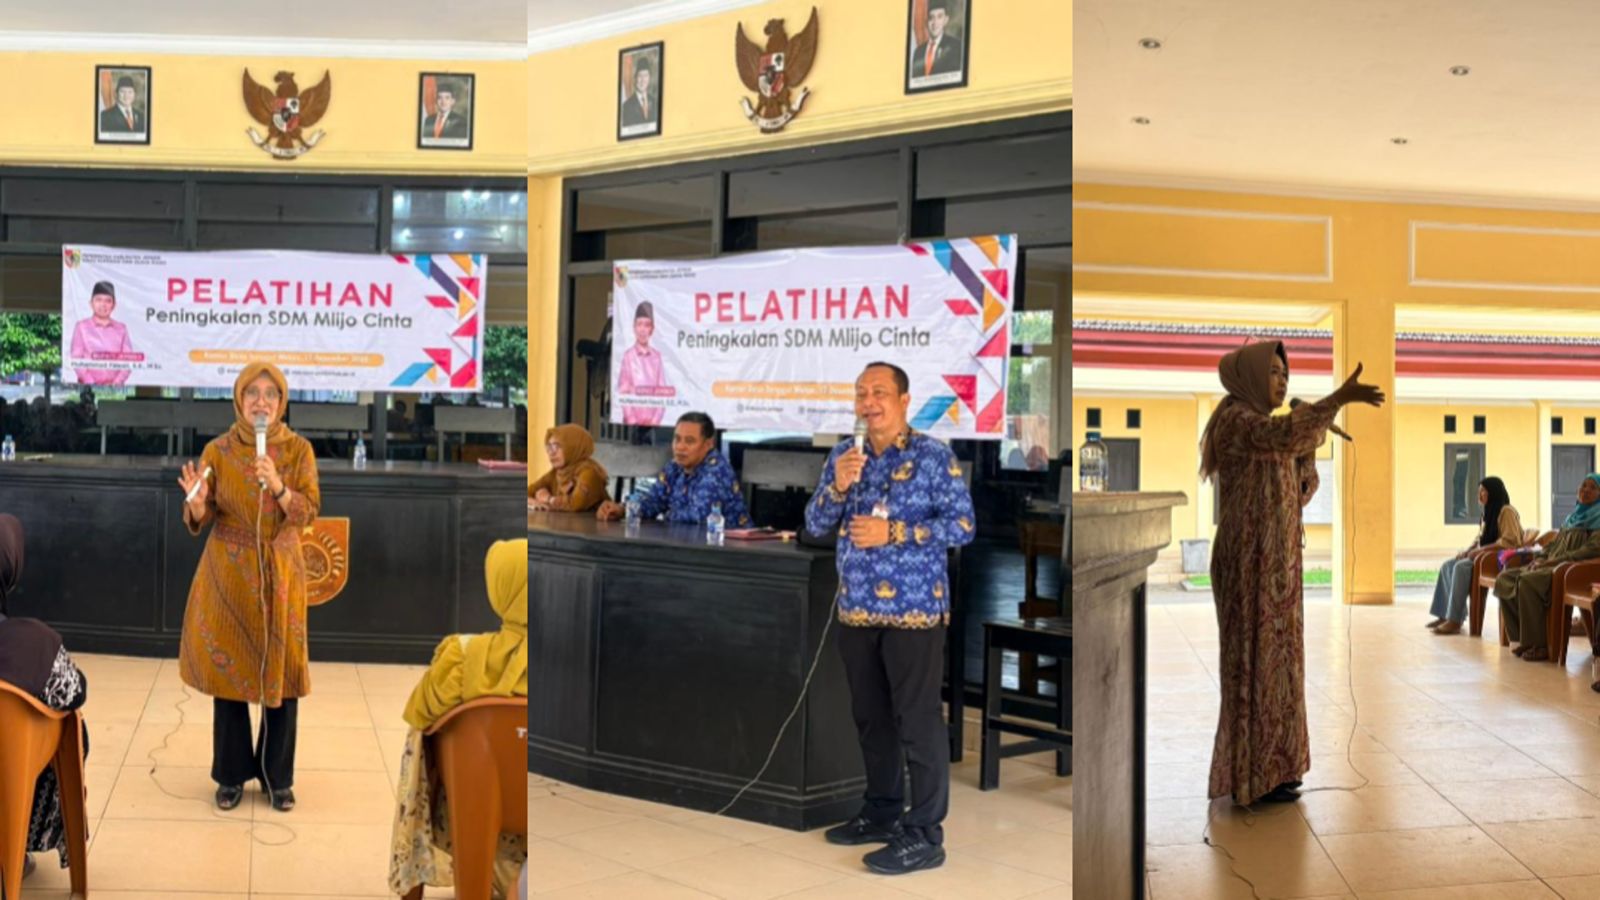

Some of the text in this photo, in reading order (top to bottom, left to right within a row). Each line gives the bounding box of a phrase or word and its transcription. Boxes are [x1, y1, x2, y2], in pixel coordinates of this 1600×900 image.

[167, 278, 393, 307] PELATIHAN
[695, 284, 909, 323] PELATIHAN
[268, 311, 308, 326] SDM
[363, 312, 412, 328] Cinta
[784, 328, 823, 347] SDM
[878, 326, 930, 347] Cinta
